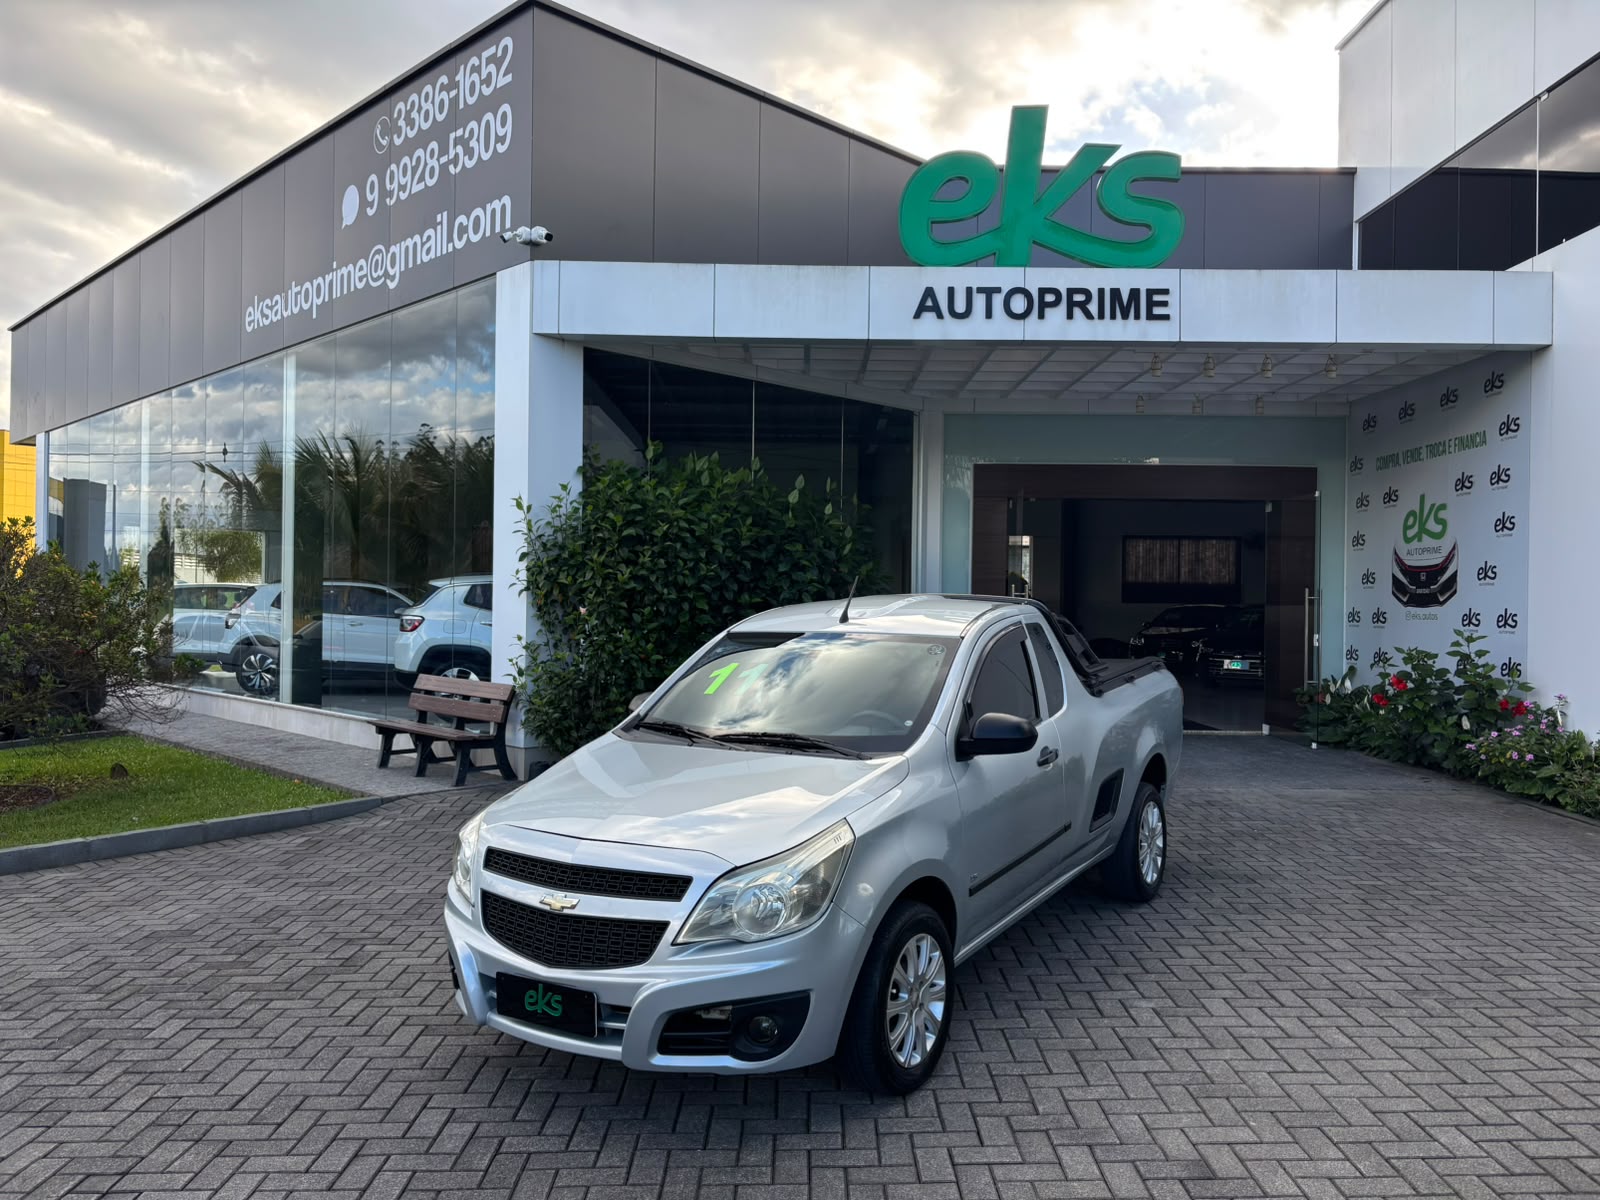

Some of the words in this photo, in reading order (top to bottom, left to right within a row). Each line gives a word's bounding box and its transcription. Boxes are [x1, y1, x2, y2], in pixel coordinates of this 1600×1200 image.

[393, 36, 513, 146] 3386-1652
[366, 173, 379, 216] 9
[385, 104, 513, 206] 9928-5309
[899, 104, 1185, 268] eks
[245, 195, 512, 332] eksautoprime@gmail.com
[912, 286, 1171, 321] AUTOPRIME
[1484, 371, 1504, 393] eks
[1440, 387, 1458, 408] eks
[1399, 401, 1415, 420] eks
[1363, 413, 1377, 432] eks
[1499, 414, 1520, 436] eks
[1425, 441, 1447, 460] TROCA
[1448, 438, 1453, 454] E
[1454, 430, 1487, 453] FINANCIA
[1350, 456, 1363, 472] eks
[1455, 472, 1474, 492] eks
[1490, 464, 1511, 486] eks
[1356, 492, 1370, 509] eks
[1383, 486, 1399, 505] eks
[1403, 494, 1448, 544] eks
[1494, 511, 1516, 533] eks
[1352, 530, 1366, 548] eks
[1406, 545, 1443, 556] AUTOPRIME
[1361, 568, 1376, 585] eks
[1477, 560, 1497, 581] eks
[1347, 606, 1361, 623] eks
[1372, 607, 1387, 625] eks
[1461, 607, 1481, 628] eks
[1496, 607, 1518, 629] eks
[1346, 645, 1359, 661] eks
[524, 983, 563, 1017] eks
